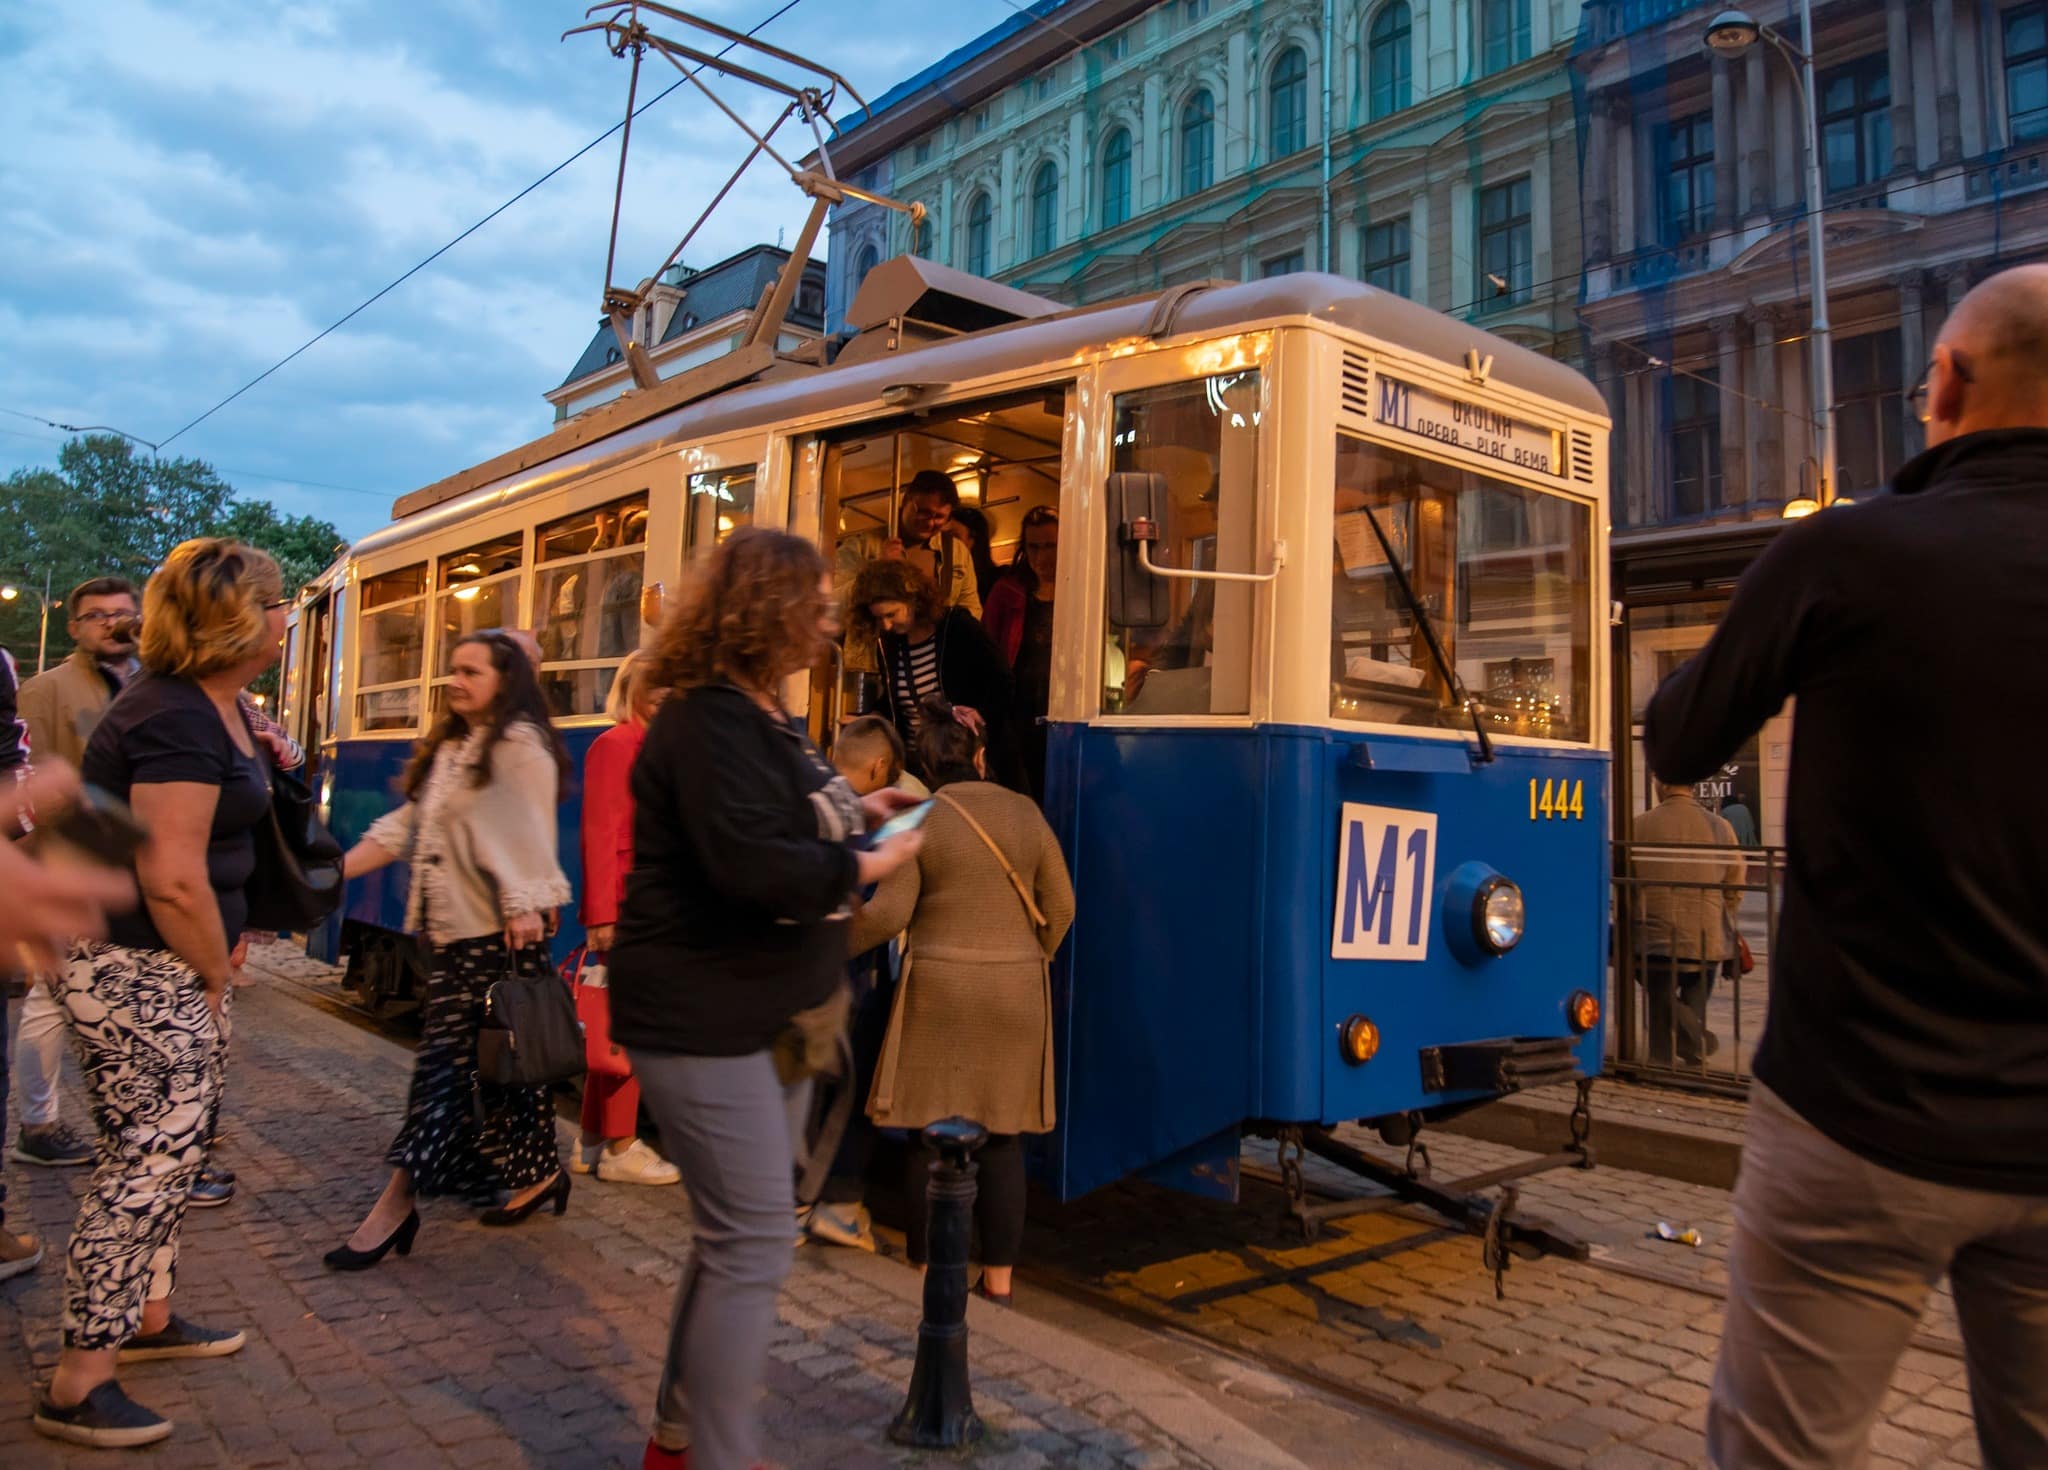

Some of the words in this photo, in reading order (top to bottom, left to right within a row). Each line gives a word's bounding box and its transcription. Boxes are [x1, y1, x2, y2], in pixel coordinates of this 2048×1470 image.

[1381, 379, 1408, 430] M1
[1529, 777, 1584, 820] 1444
[1341, 820, 1428, 945] M1
